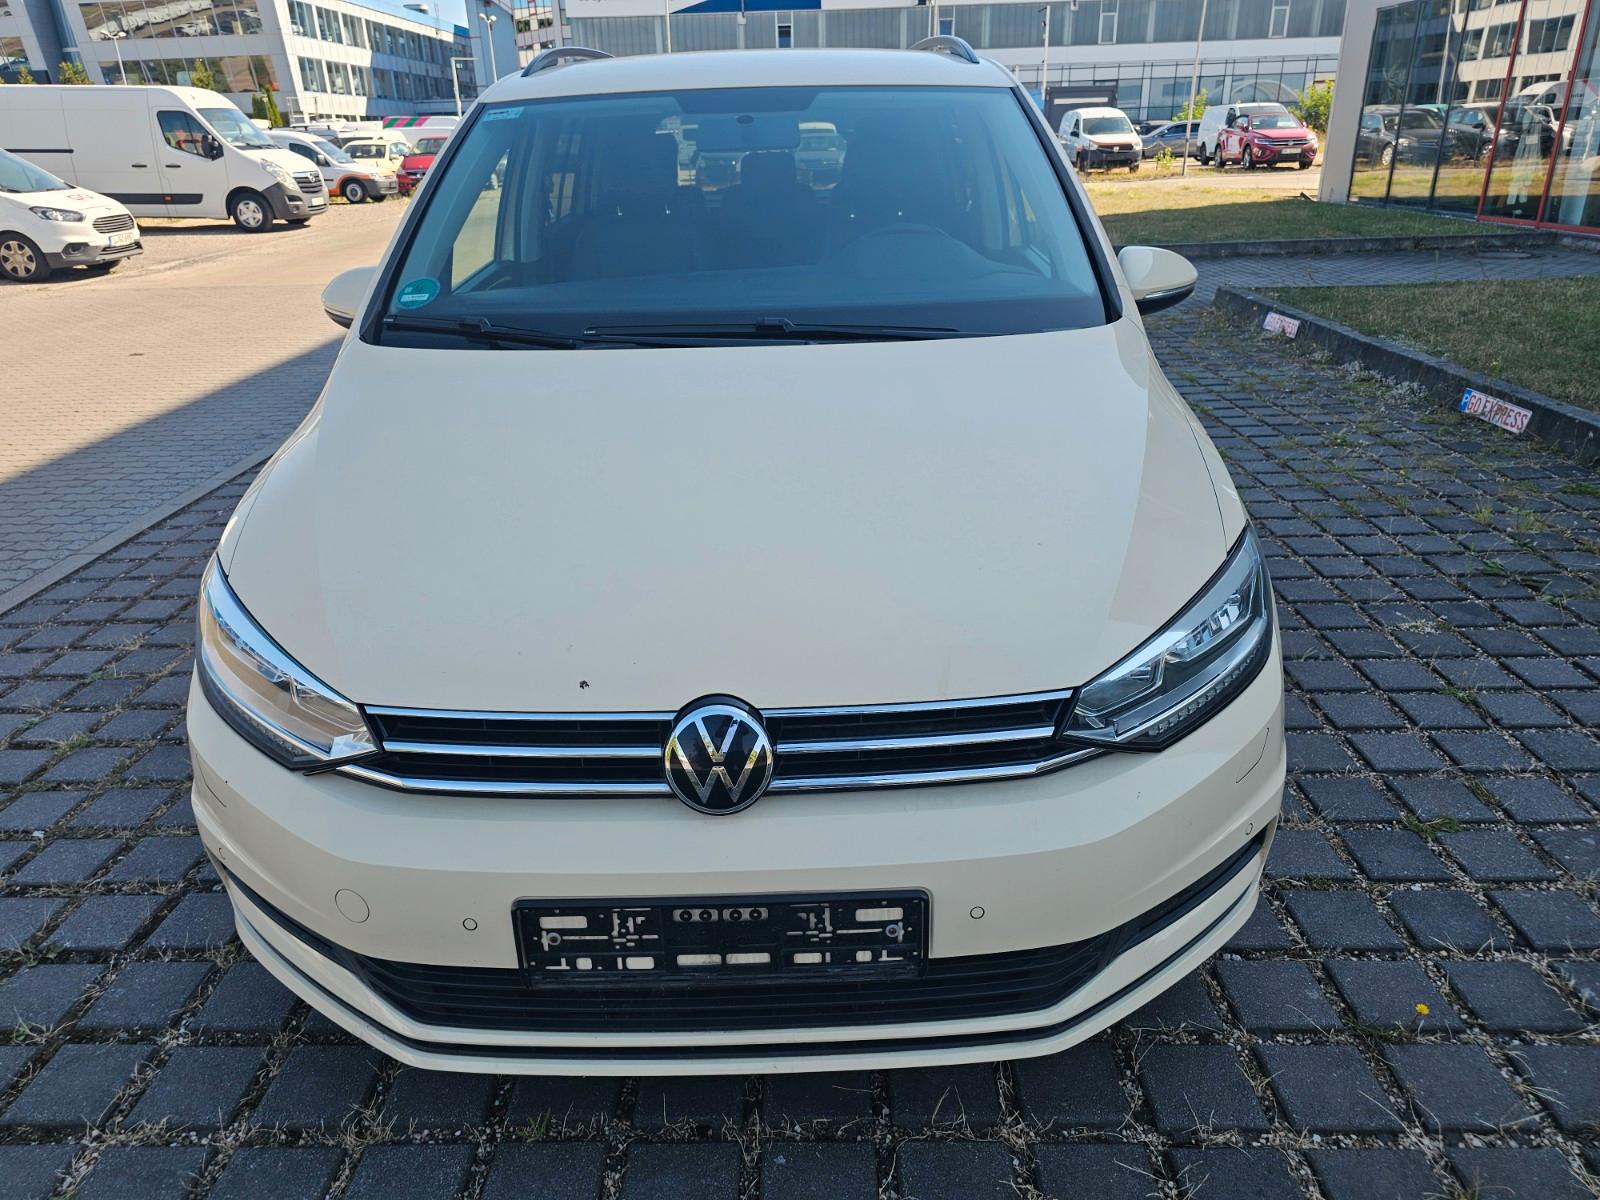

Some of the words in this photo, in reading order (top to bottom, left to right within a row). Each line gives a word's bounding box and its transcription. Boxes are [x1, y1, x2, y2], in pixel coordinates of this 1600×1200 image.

[1467, 394, 1482, 413] GO
[1482, 399, 1528, 430] EXPRESS
[669, 708, 770, 808] VW
